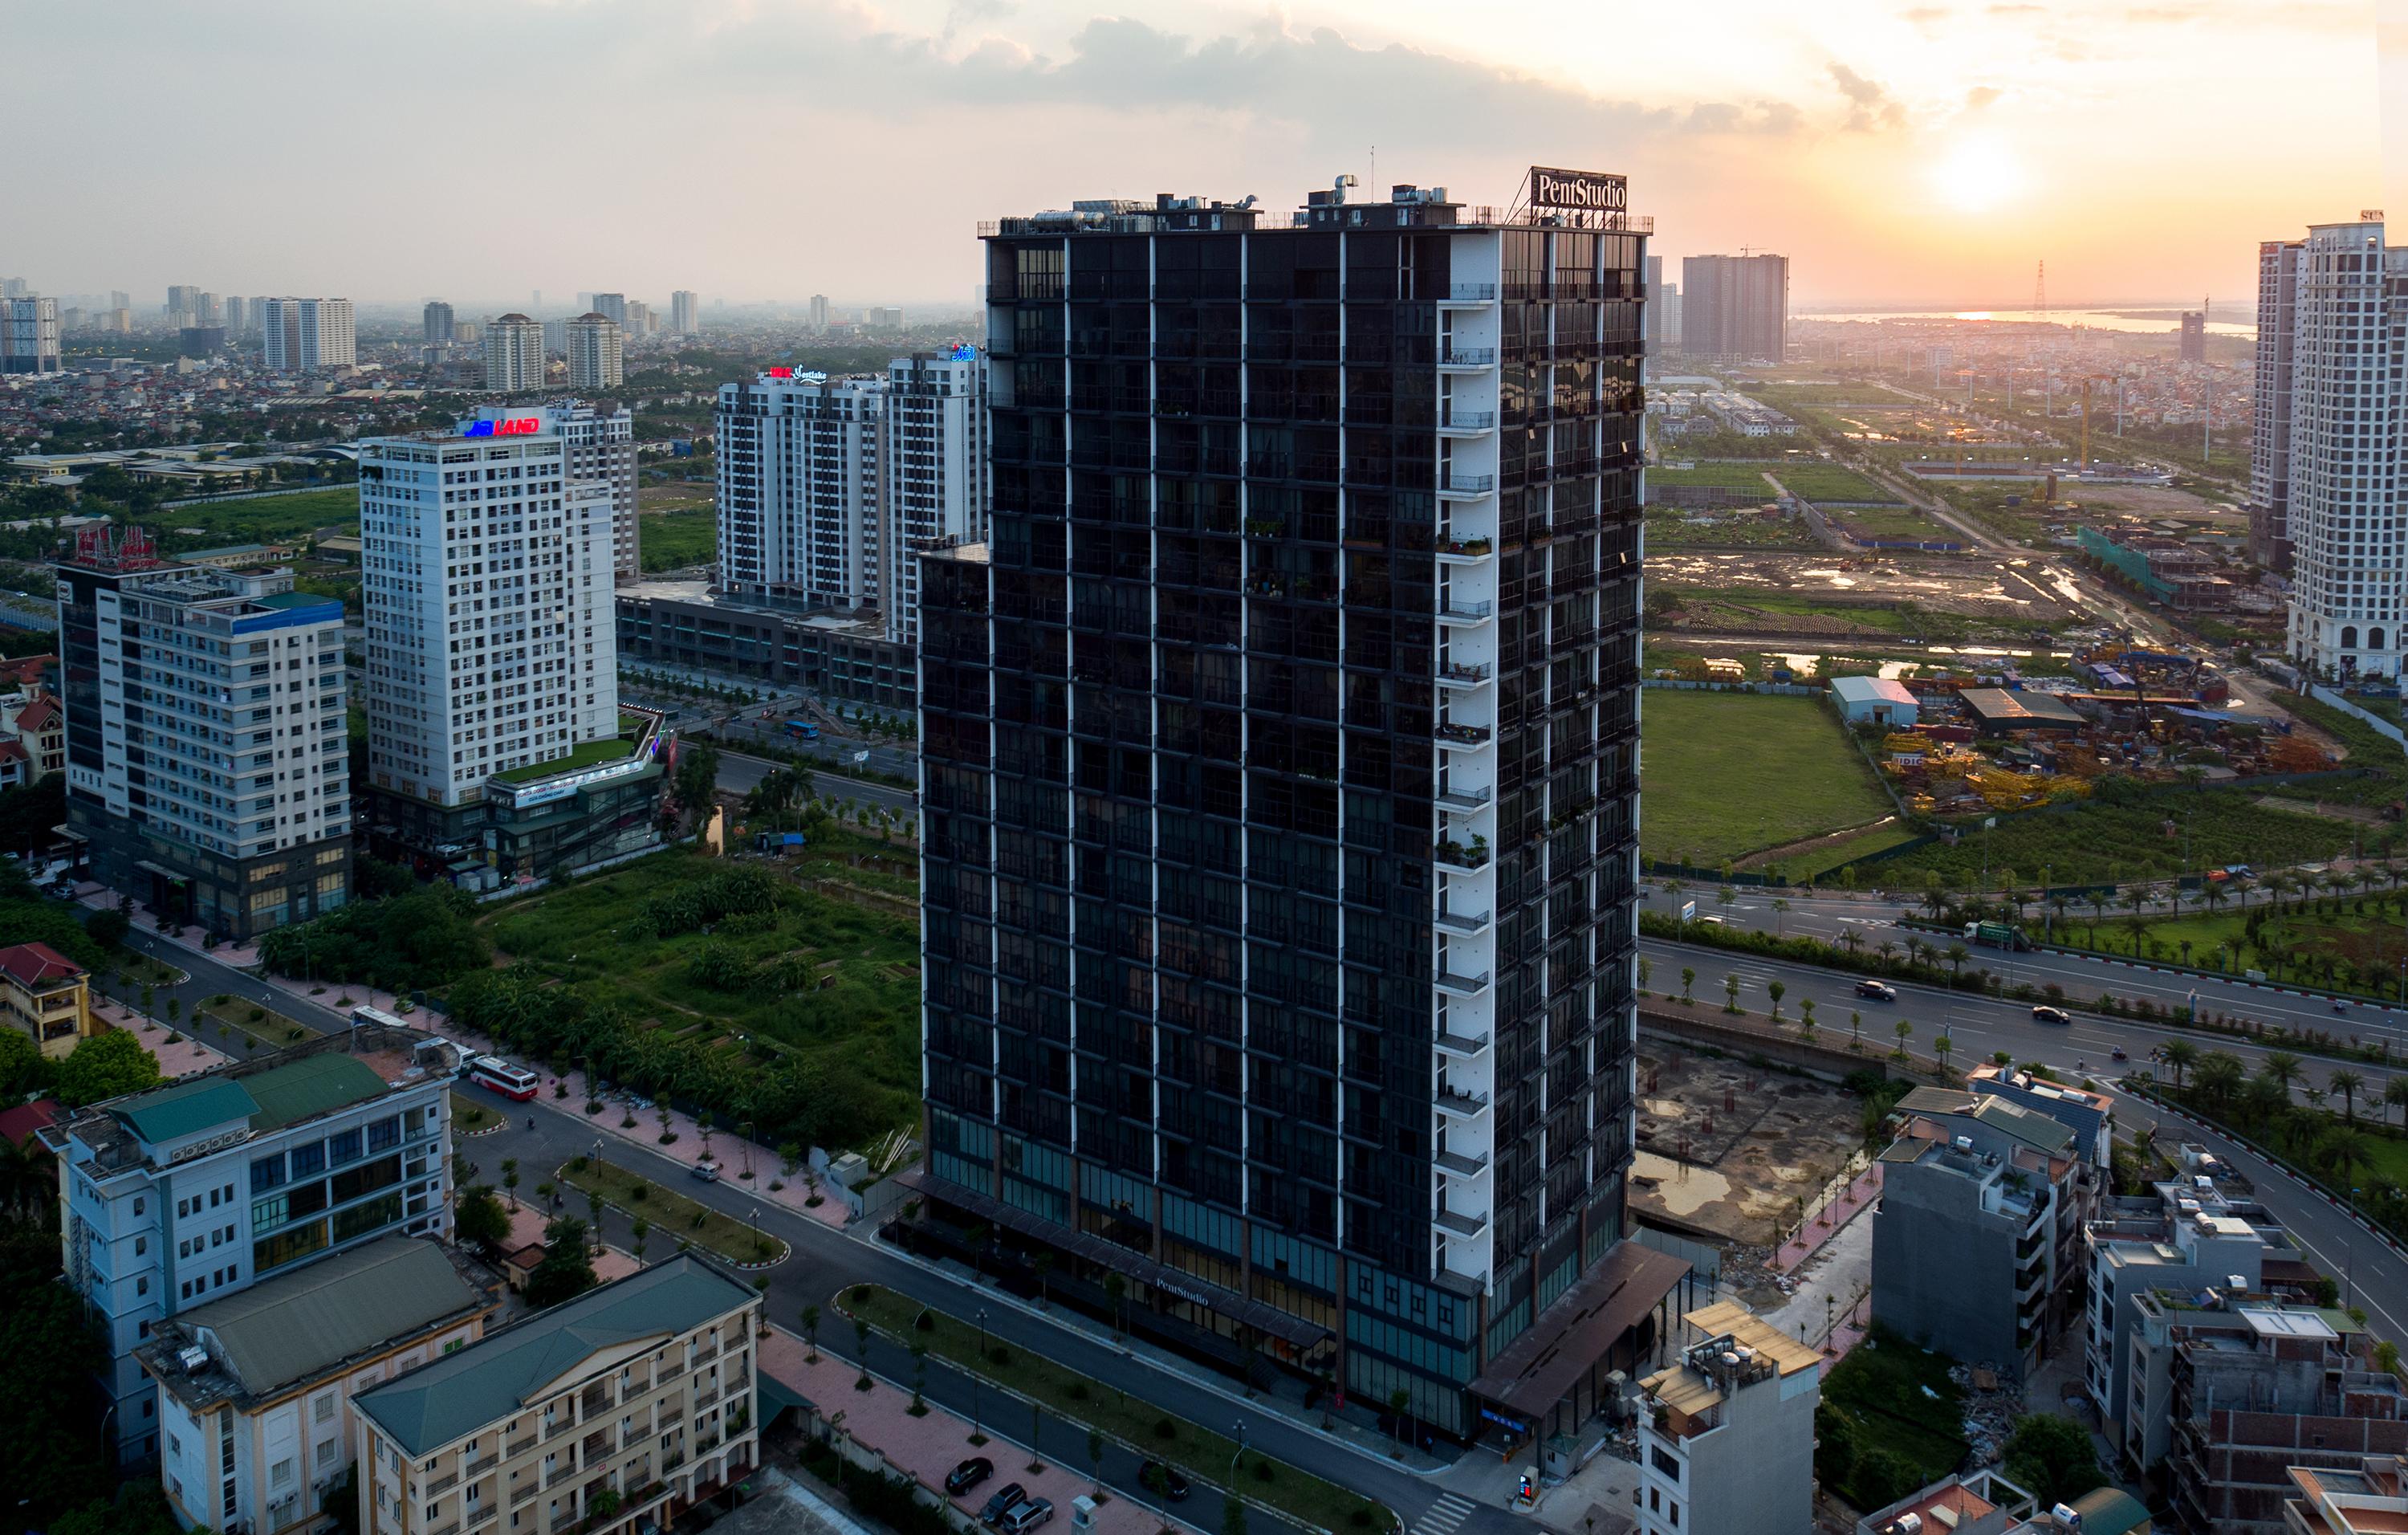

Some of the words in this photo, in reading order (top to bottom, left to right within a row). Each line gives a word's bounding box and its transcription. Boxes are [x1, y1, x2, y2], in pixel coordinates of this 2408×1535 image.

[1538, 174, 1625, 208] PentStudio
[1978, 676, 2002, 684] UC
[1156, 1277, 1209, 1306] PentStudio
